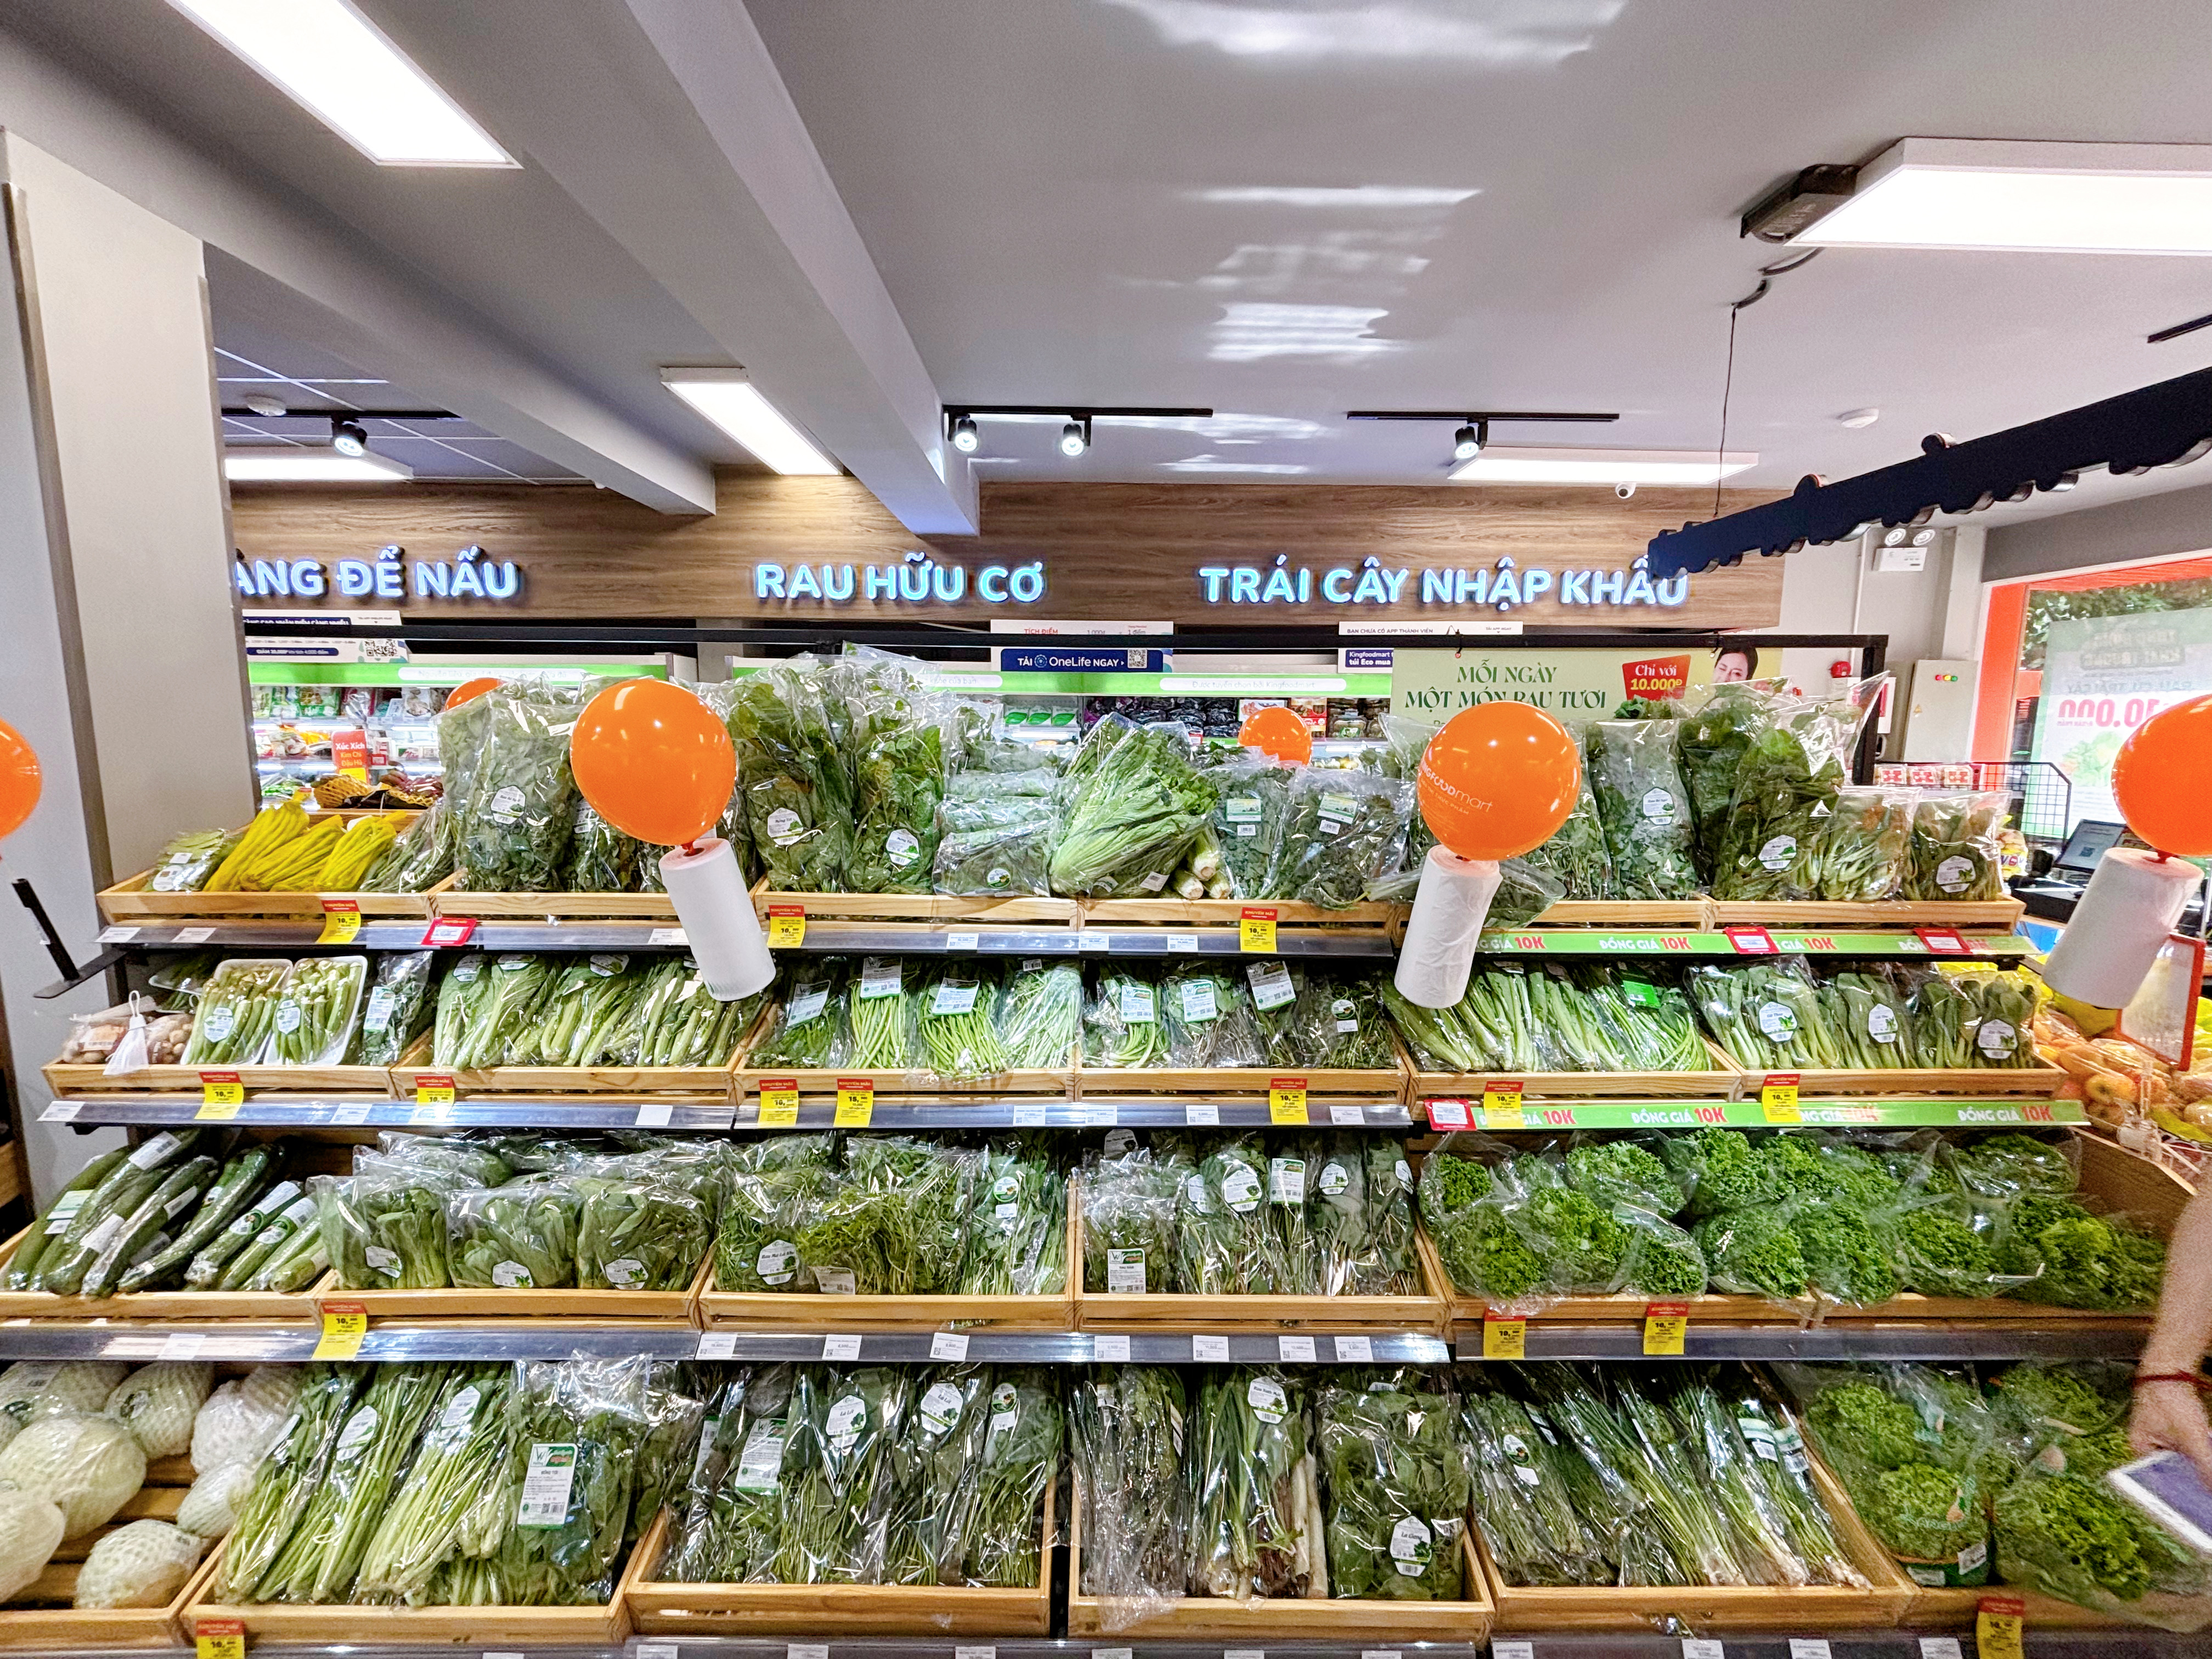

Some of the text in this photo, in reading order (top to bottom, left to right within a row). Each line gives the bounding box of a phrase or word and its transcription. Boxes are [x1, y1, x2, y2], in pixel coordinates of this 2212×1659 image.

[335, 544, 404, 597] ĐỂ
[415, 544, 520, 597] NẤU
[755, 551, 1045, 602] RAU HỮU CƠ
[1199, 554, 1311, 604] TRÁI
[1323, 556, 1410, 604] CÂY
[1422, 556, 1552, 611] NHẬP
[1017, 656, 1119, 667] TẢI OneLife NGAY
[1457, 659, 1557, 683] MỖI NGÀY
[1635, 664, 1678, 676] Chỉ với
[1212, 680, 1233, 690] tuyển
[1234, 681, 1251, 690] chọn
[1266, 681, 1315, 690] Kingfoodmart
[1405, 686, 1453, 713] MỘT
[1459, 688, 1507, 708] MÓN
[1559, 690, 1606, 708] TƯƠI
[1514, 936, 1546, 949] 10K
[1599, 936, 1692, 950] ĐỒNG GIÁ 10K
[1781, 939, 1805, 950] GIÁ
[1803, 937, 1838, 950] 10K
[1543, 1109, 1577, 1125] 10K
[1631, 1107, 1728, 1124] ĐỒNG GIÁ 10K
[1957, 1105, 2055, 1121] ĐỒNG GIÁ 10K
